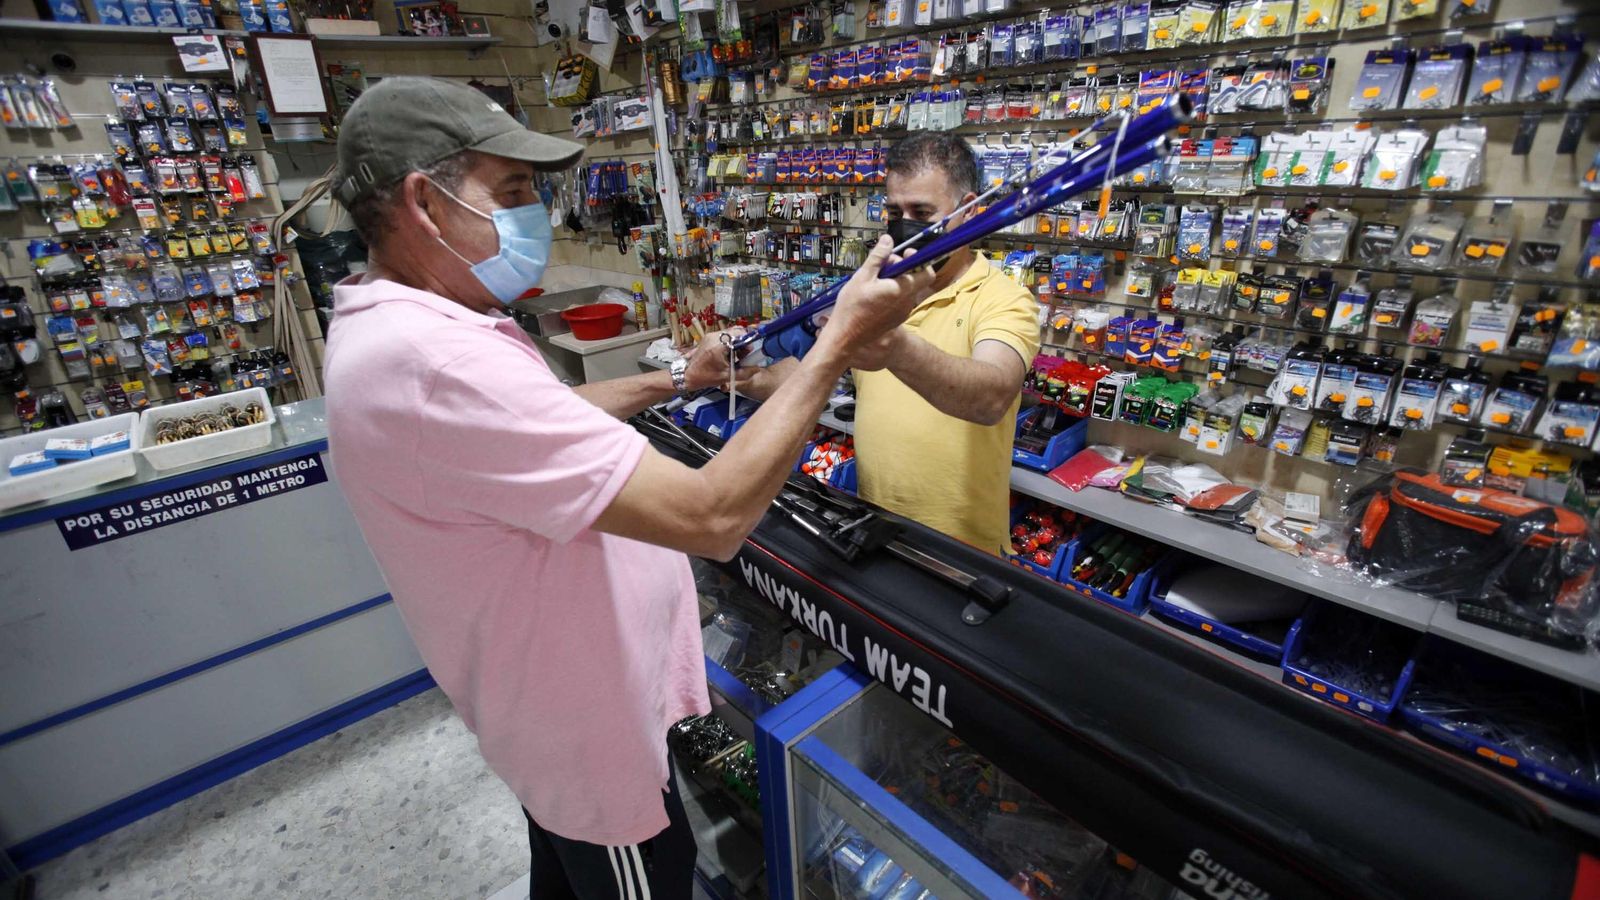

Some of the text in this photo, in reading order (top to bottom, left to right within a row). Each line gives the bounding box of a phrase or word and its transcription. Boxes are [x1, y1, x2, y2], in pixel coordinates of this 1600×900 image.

[1416, 314, 1449, 325] Mustad
[1334, 435, 1357, 443] Mustad
[64, 458, 318, 531] POR SU SEGURIDAD MANTENGA
[94, 475, 305, 539] LA DISTANCIA DE 1 METRO
[740, 557, 953, 728] TEAM TURKANA
